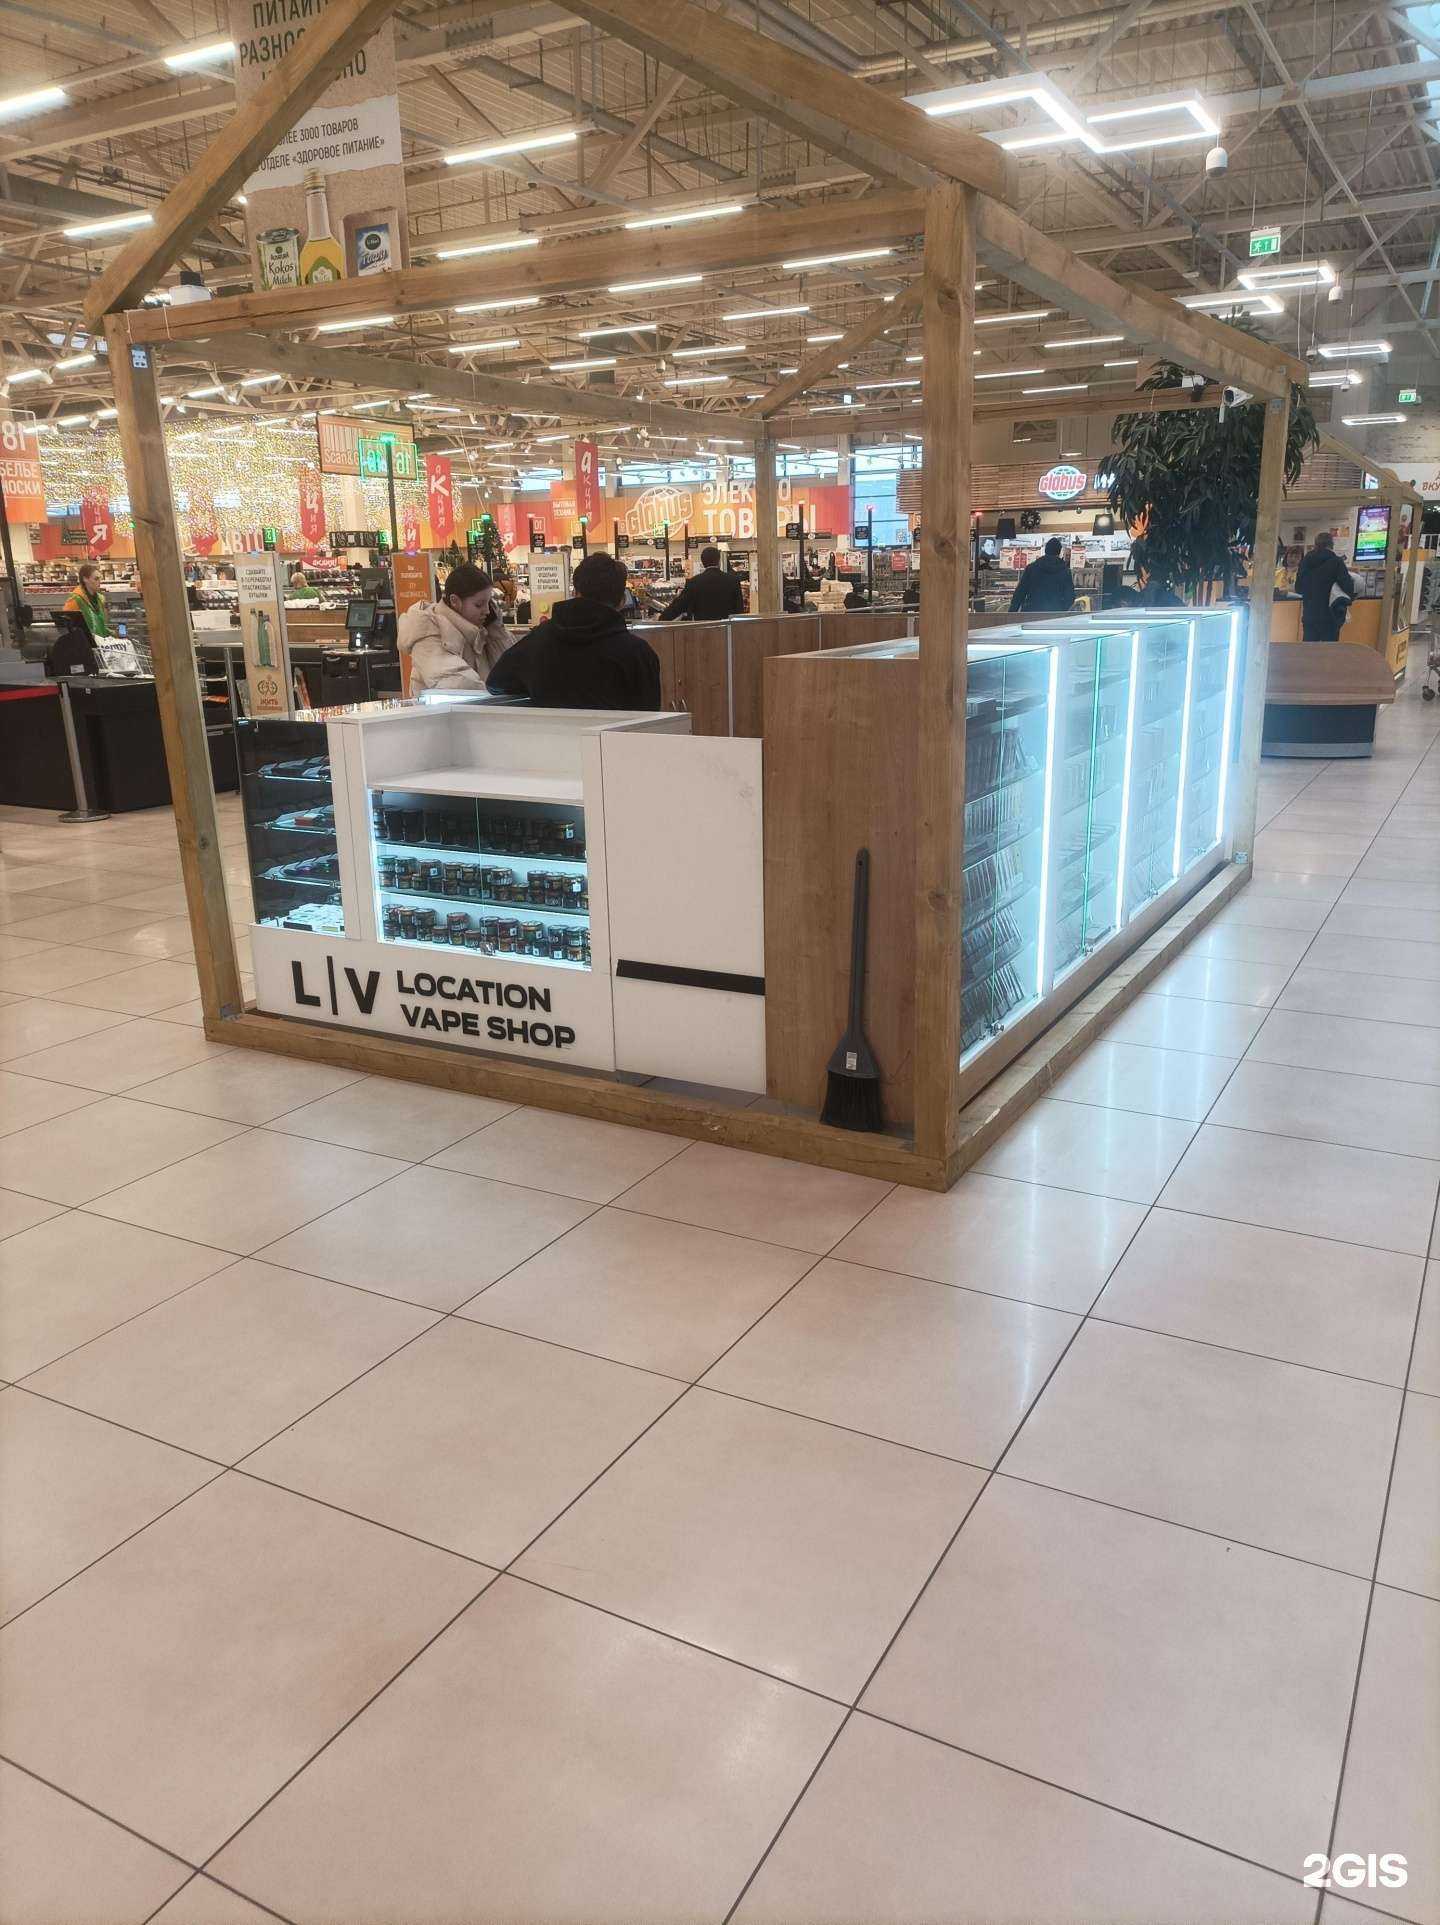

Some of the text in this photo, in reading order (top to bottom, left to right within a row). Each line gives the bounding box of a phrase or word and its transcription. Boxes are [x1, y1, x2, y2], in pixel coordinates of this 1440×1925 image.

[300, 126, 320, 141] 3000
[321, 118, 359, 137] ТОВАРОВ
[260, 135, 385, 171] ОТДЕЛЕ «ЗДОРОВОЕ ПИТАНИЕ»
[269, 261, 294, 275] Kokos
[703, 479, 792, 504] ЭЛЕКО
[704, 504, 816, 538] ТОВРЫ
[397, 970, 552, 1012] LOCATION
[401, 1004, 575, 1048] VAPE SHOP
